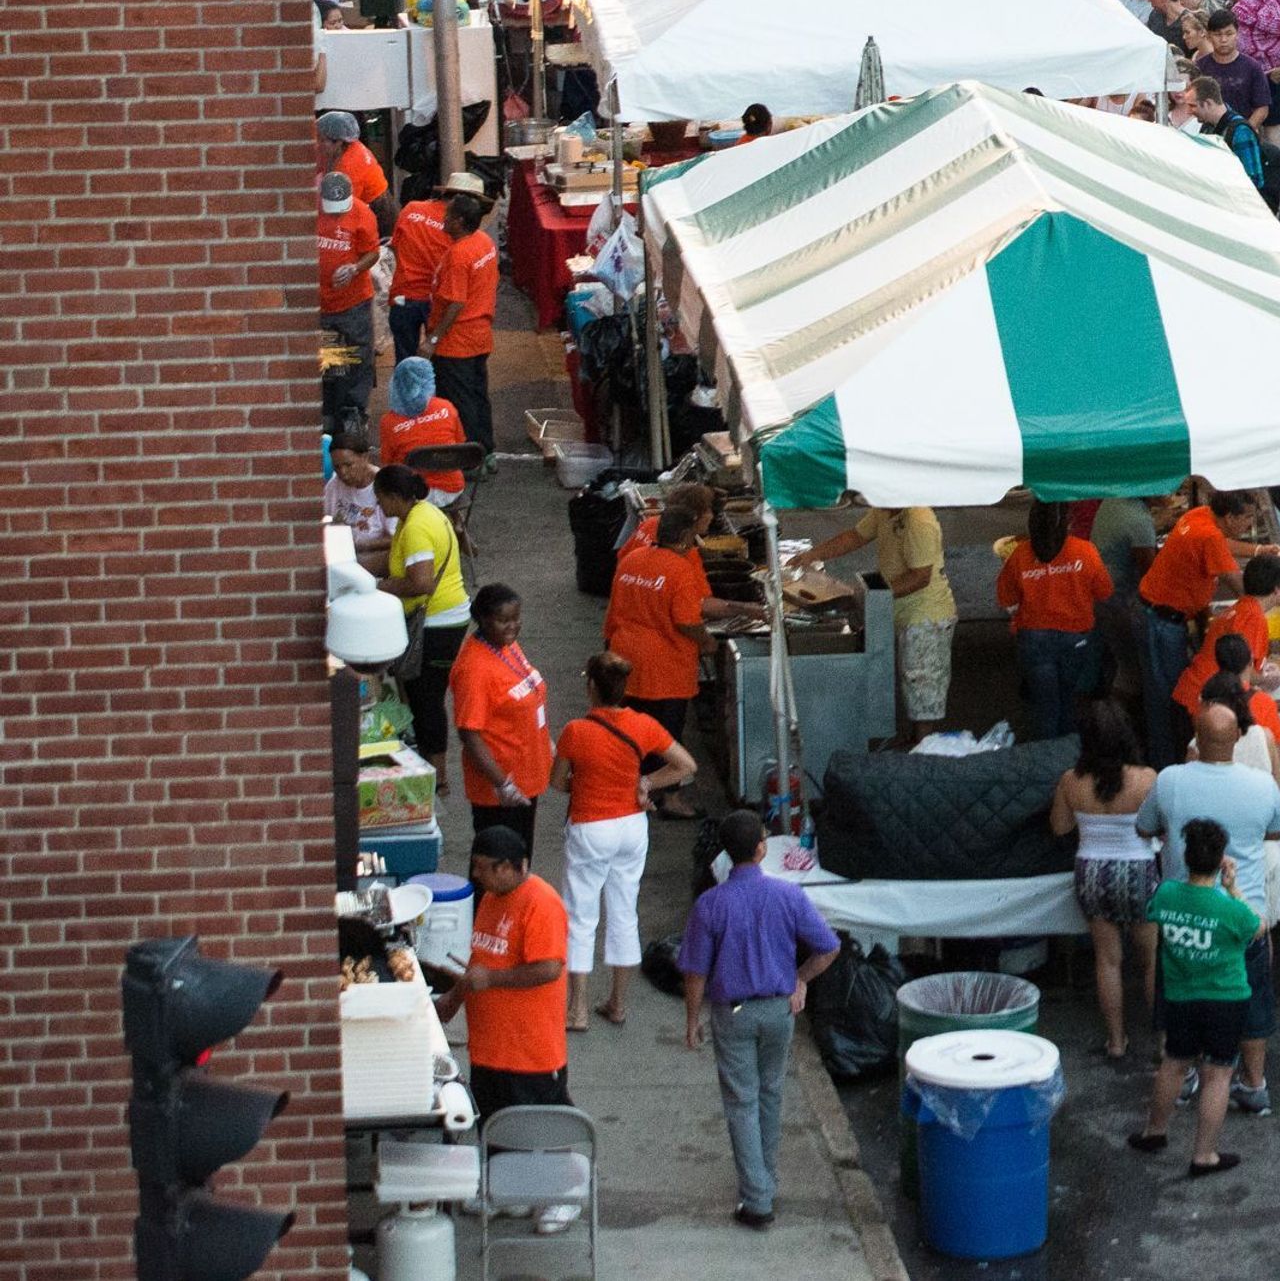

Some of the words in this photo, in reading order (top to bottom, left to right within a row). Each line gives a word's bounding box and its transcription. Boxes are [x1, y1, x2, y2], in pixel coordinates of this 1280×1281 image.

[393, 419, 415, 433] sage
[1022, 568, 1046, 580] sage
[1047, 562, 1073, 576] bank
[1160, 909, 1193, 925] WHAT
[1193, 914, 1219, 928] CAN
[1163, 923, 1212, 950] DCU
